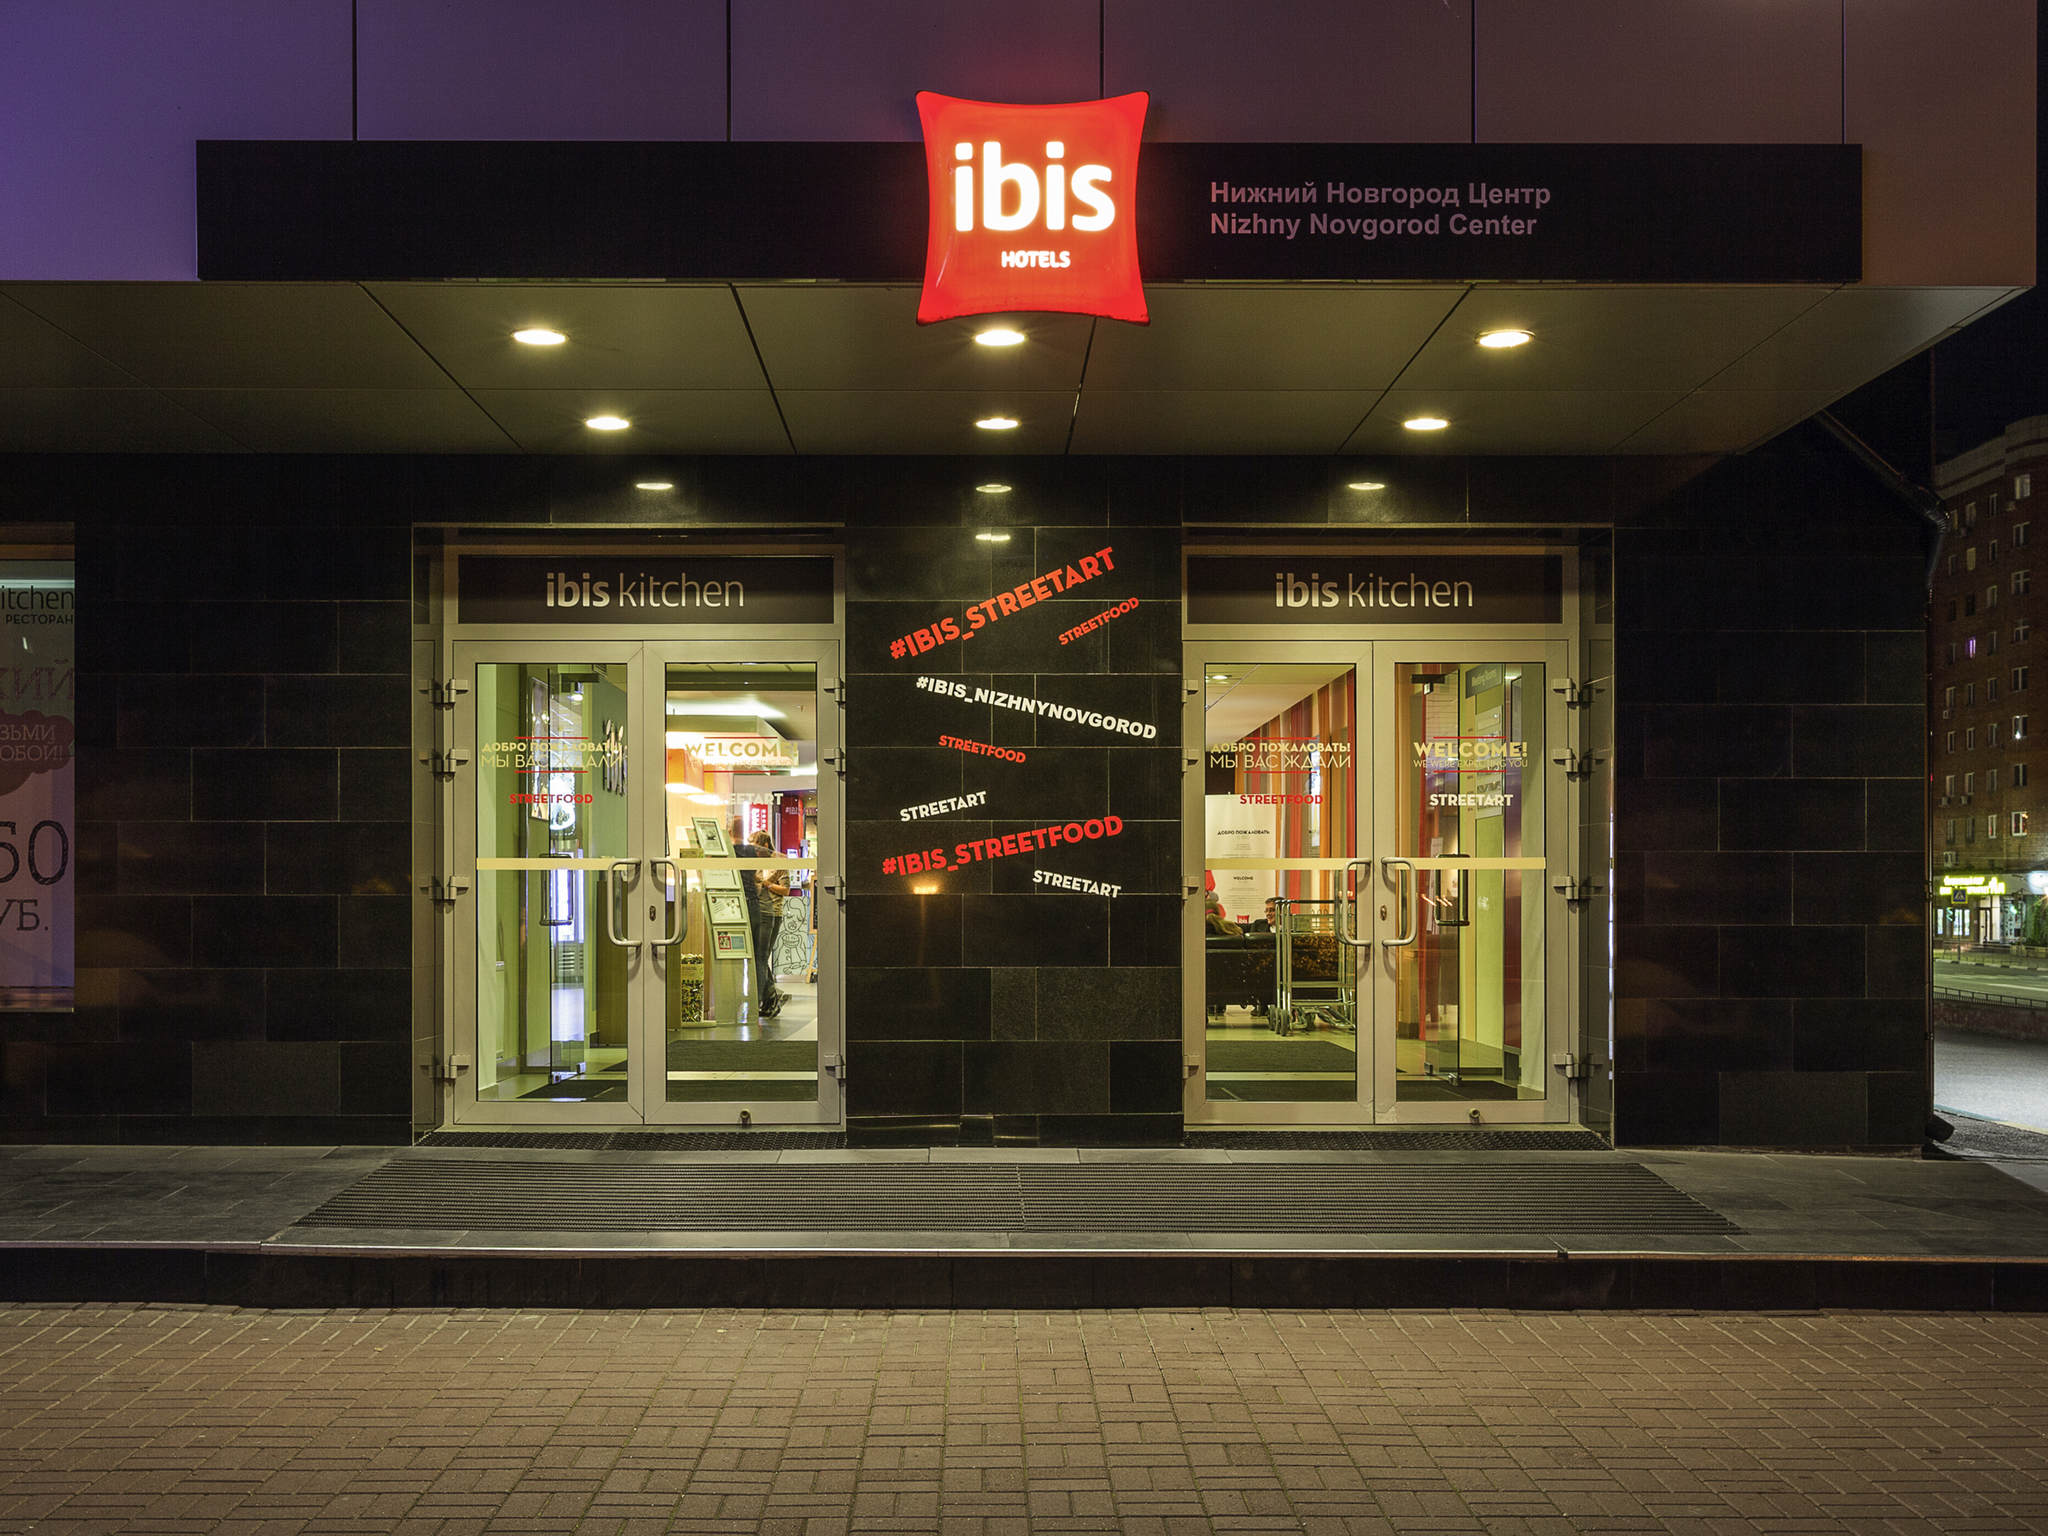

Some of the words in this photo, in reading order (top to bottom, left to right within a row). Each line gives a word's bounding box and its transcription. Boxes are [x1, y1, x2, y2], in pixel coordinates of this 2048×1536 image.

[955, 141, 1116, 231] ibis
[1210, 181, 1318, 203] Нижний
[1327, 182, 1460, 209] Новгород
[1469, 182, 1551, 209] Центр
[1210, 213, 1301, 240] Nizhny
[1310, 213, 1440, 240] Novgorod
[1450, 213, 1538, 235] Center
[1001, 251, 1071, 269] HOTELS
[0, 585, 74, 610] itchen
[546, 573, 611, 608] ibis
[619, 573, 745, 608] kitchen
[889, 546, 1115, 660] #IBIS_STREETART
[1275, 573, 1340, 608] ibis
[1348, 573, 1473, 608] kitchen
[5, 614, 74, 625] РЕСТОРАН
[1058, 597, 1140, 646] STREETFOOD
[916, 675, 1157, 740] #IBIS_NIZHNYNOVGOROD
[0, 724, 56, 741] ЗЬМИ
[0, 742, 64, 761] ОБОЙ!
[481, 742, 527, 753] ДОБРО
[938, 735, 1027, 764] STREETFOOD
[1210, 742, 1256, 753] ДОБРО
[1259, 742, 1351, 753] ПОЖАЛОВАТЬ!
[1413, 742, 1528, 758] WELCOME!
[481, 754, 509, 768] МЫ
[515, 754, 549, 768] ВАС
[553, 754, 623, 769] ЖДАЛИ
[1210, 754, 1239, 768] МЫ
[1244, 754, 1279, 768] ВАС
[1281, 754, 1351, 769] ЖДАЛИ
[1413, 760, 1427, 768] WE
[1431, 760, 1456, 768] WERE
[1508, 760, 1528, 768] YOU
[509, 793, 593, 805] STREETFOOD
[900, 791, 987, 822] STREETART
[1240, 794, 1323, 805] STREETFOOD
[1429, 793, 1514, 807] STREETART
[882, 815, 1124, 876] #IBIS_STREETFOOD
[1033, 870, 1122, 898] STREETART
[0, 900, 49, 931] УБ.
